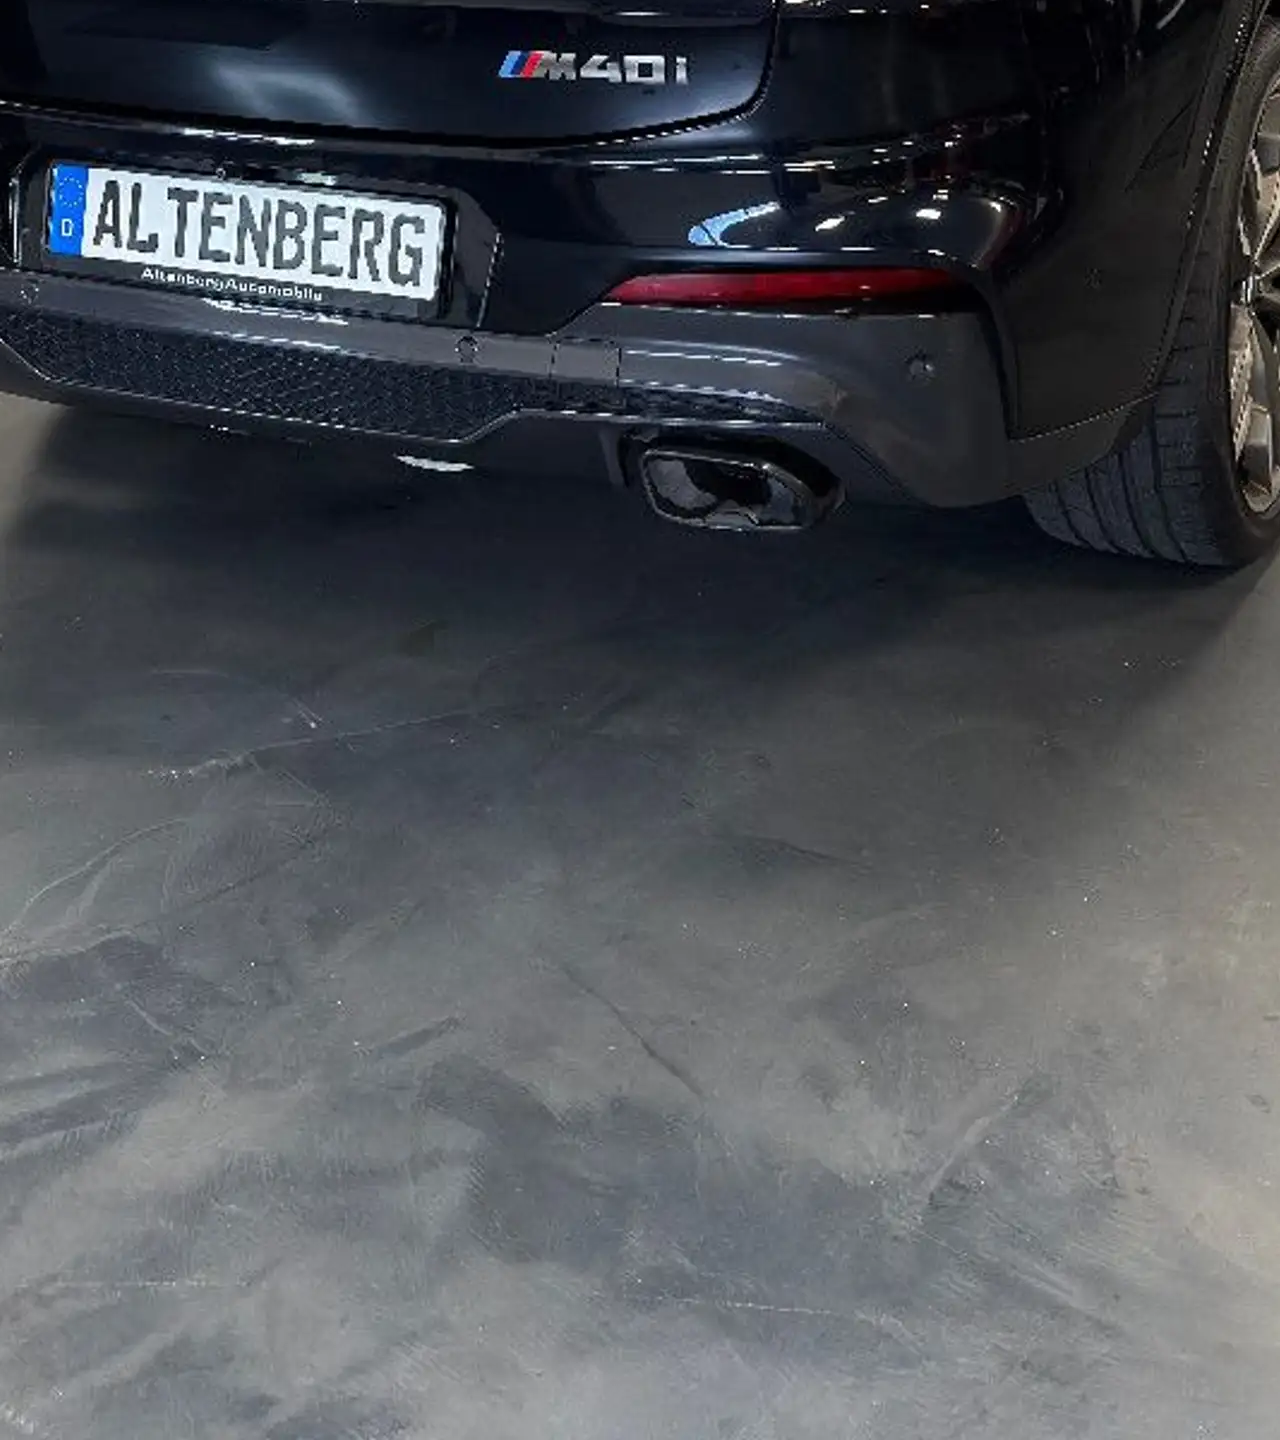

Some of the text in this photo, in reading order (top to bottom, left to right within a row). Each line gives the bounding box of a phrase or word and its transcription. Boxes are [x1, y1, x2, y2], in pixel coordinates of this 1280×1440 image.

[536, 50, 689, 86] M40i
[61, 218, 73, 236] D
[92, 179, 426, 288] ALTENBERG
